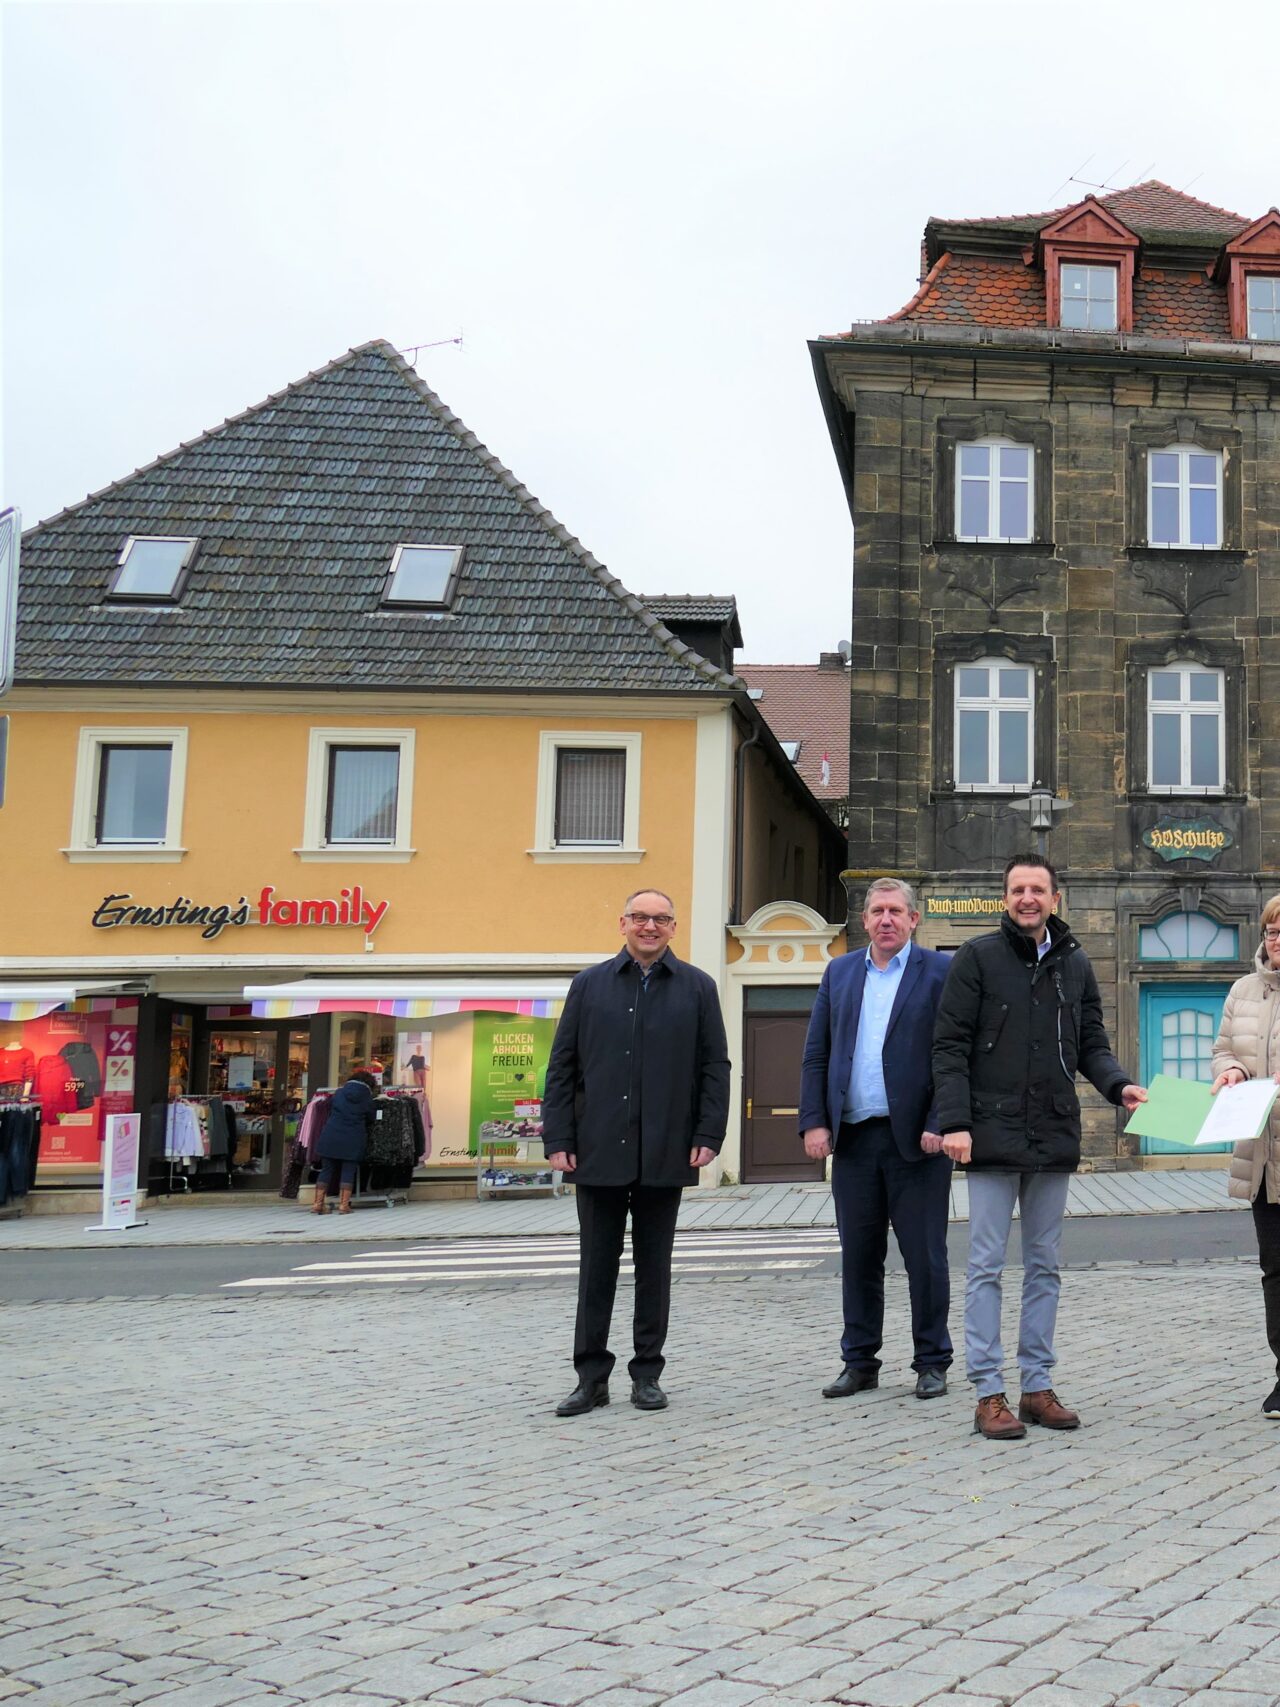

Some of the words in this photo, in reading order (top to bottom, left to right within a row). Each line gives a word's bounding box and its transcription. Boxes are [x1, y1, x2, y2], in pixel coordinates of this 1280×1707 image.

[92, 893, 248, 939] Ernsting's
[258, 886, 388, 934] family
[493, 1033, 534, 1044] KLICKEN
[492, 1045, 534, 1054] ABHOLEN
[492, 1055, 533, 1066] FREUEN
[64, 1081, 85, 1093] 59,99
